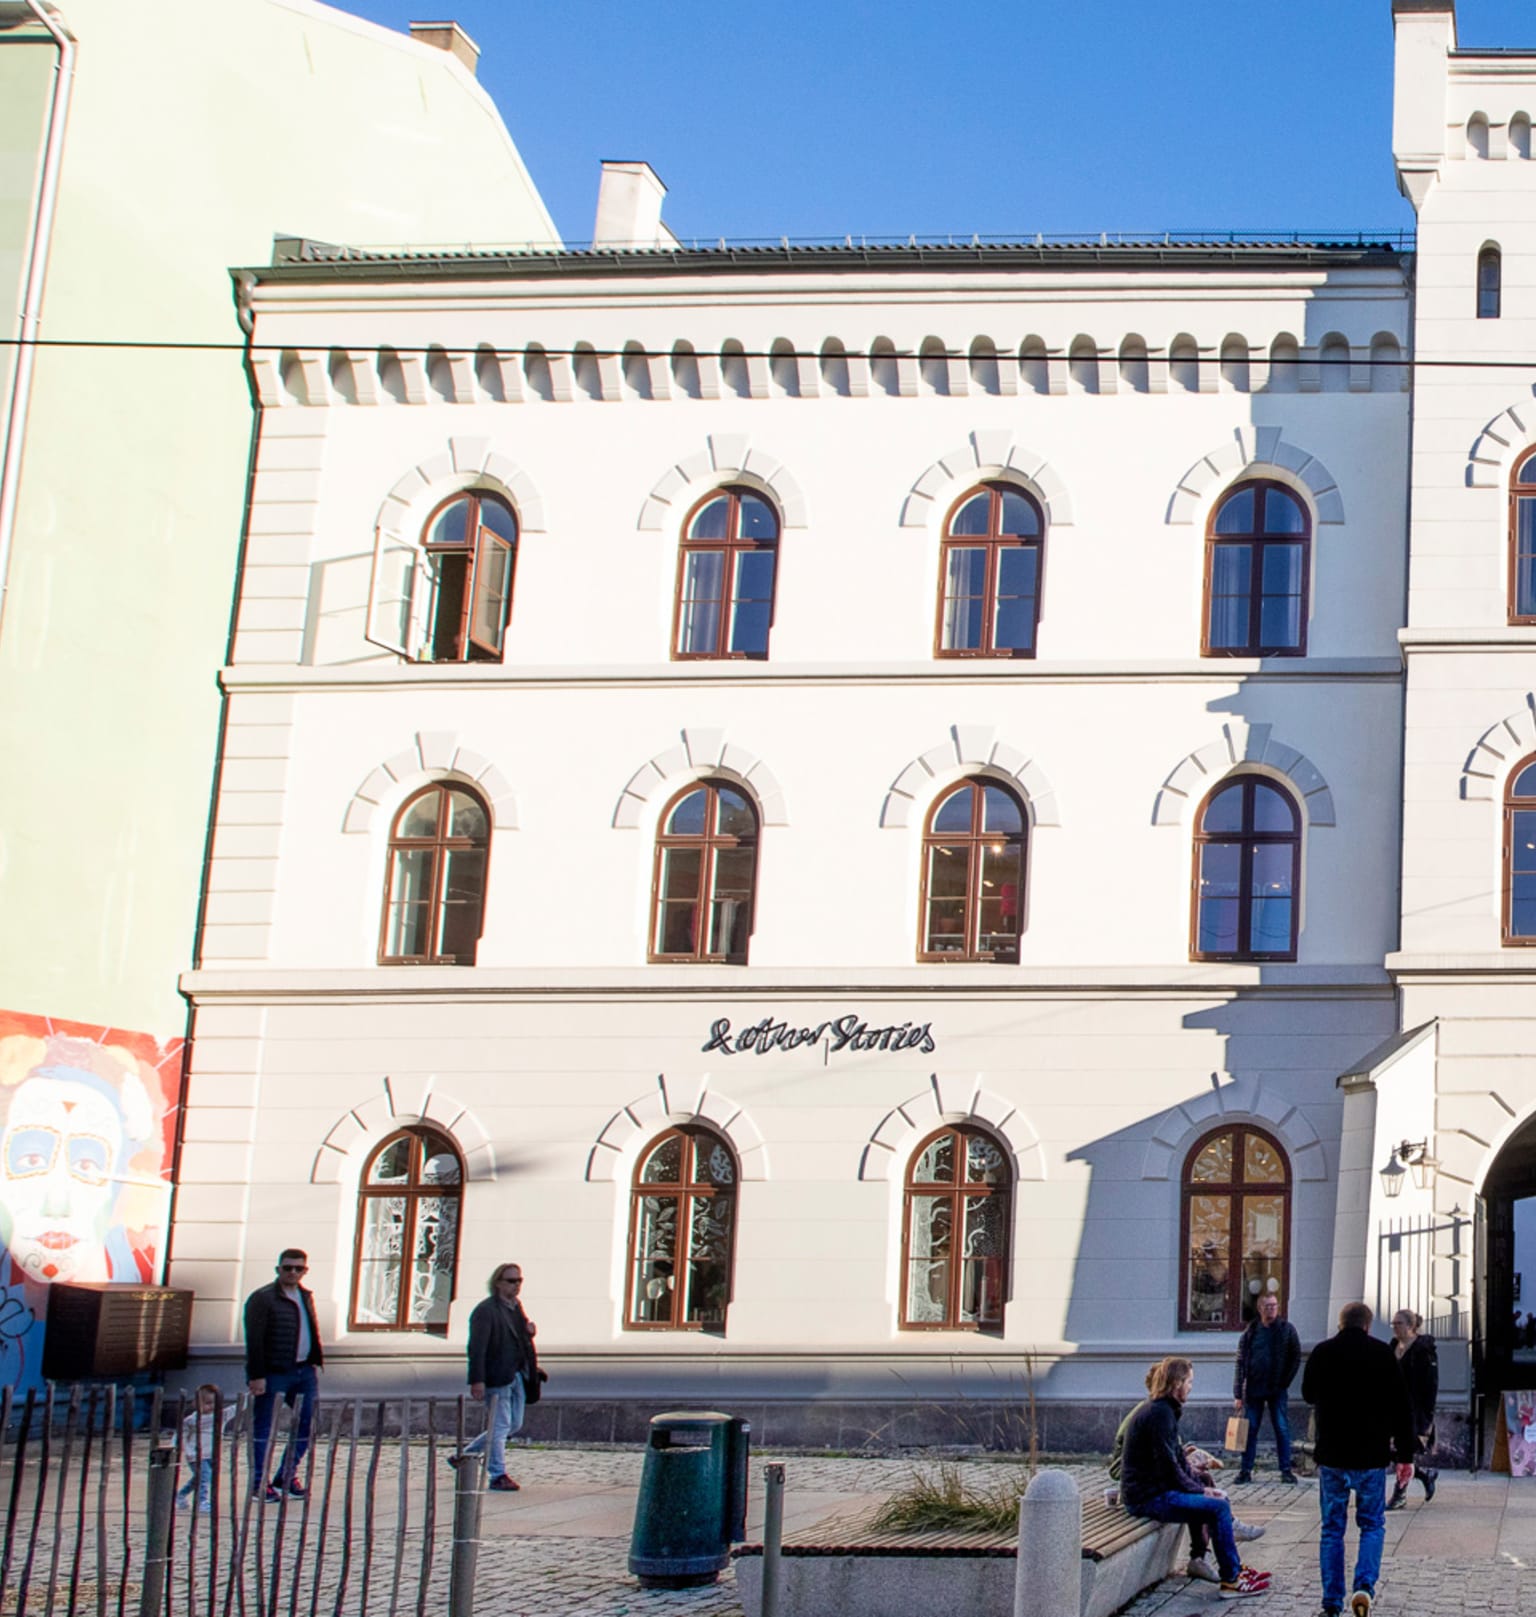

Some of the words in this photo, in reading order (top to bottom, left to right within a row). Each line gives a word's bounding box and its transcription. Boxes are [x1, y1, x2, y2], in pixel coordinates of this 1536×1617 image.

[701, 1018, 735, 1055] &
[736, 1017, 831, 1055] other
[828, 1014, 935, 1054] Stories
